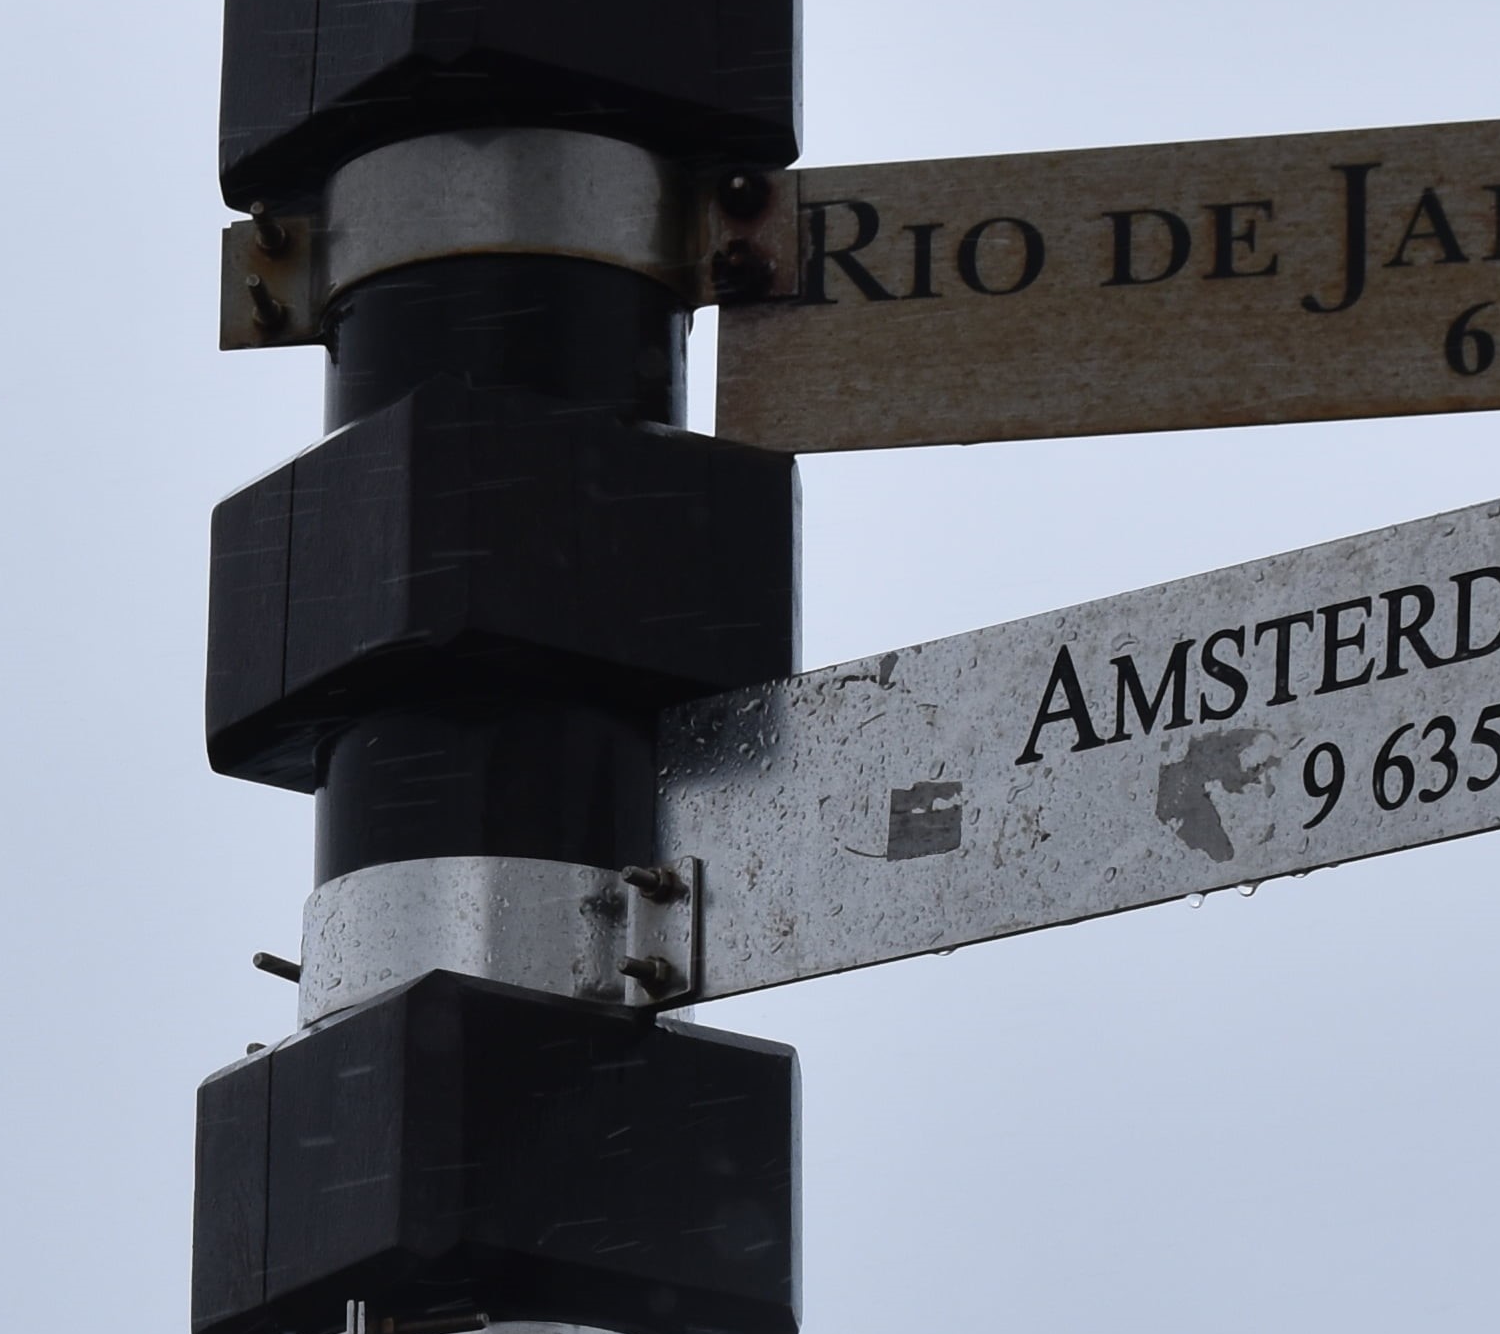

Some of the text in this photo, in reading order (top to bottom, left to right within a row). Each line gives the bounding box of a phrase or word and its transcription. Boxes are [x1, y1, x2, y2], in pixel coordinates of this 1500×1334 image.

[796, 198, 1048, 307] RIO
[1096, 197, 1281, 289] DE
[1441, 298, 1497, 379] 6
[1301, 740, 1347, 831] 9
